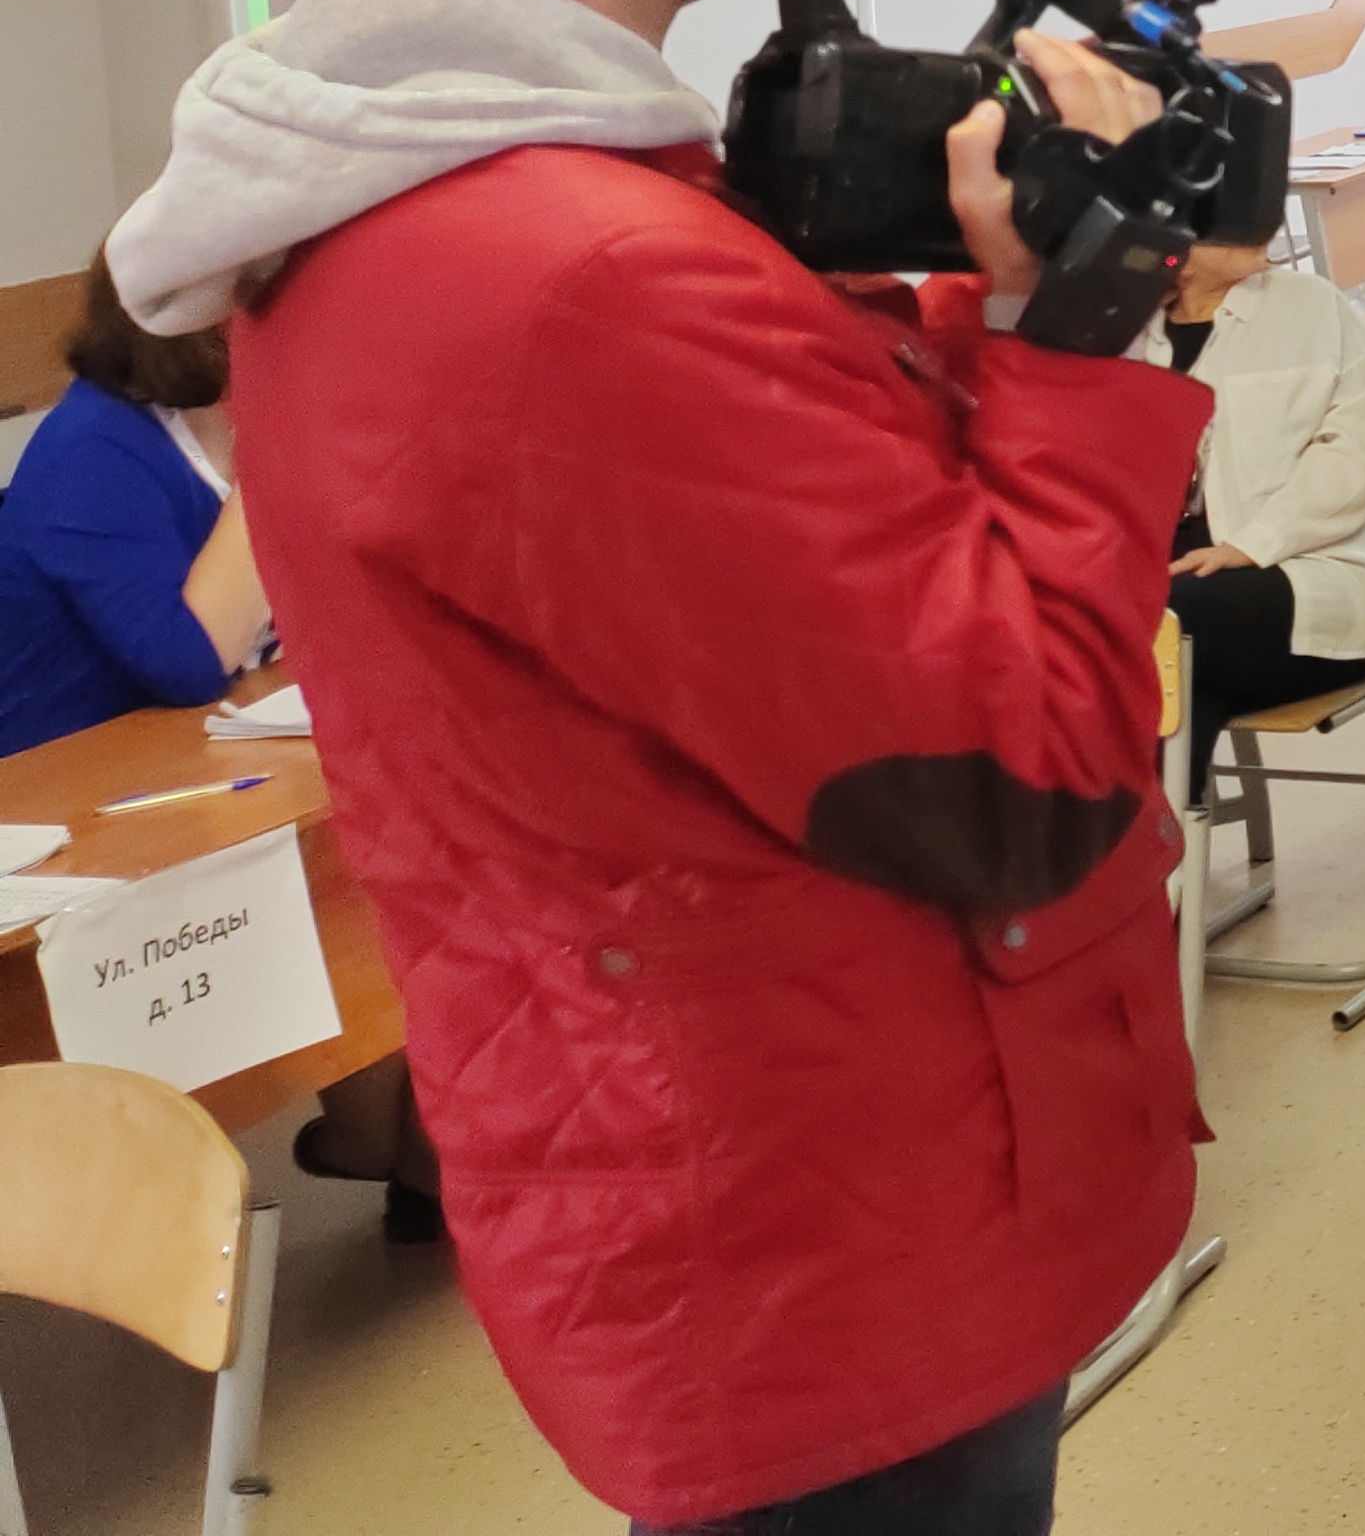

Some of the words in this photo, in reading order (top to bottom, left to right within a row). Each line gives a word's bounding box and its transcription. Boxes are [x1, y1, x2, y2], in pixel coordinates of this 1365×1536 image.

[93, 958, 135, 988] Ул.
[142, 908, 250, 967] Победы
[148, 997, 173, 1027] д.
[181, 972, 212, 1004] 13
